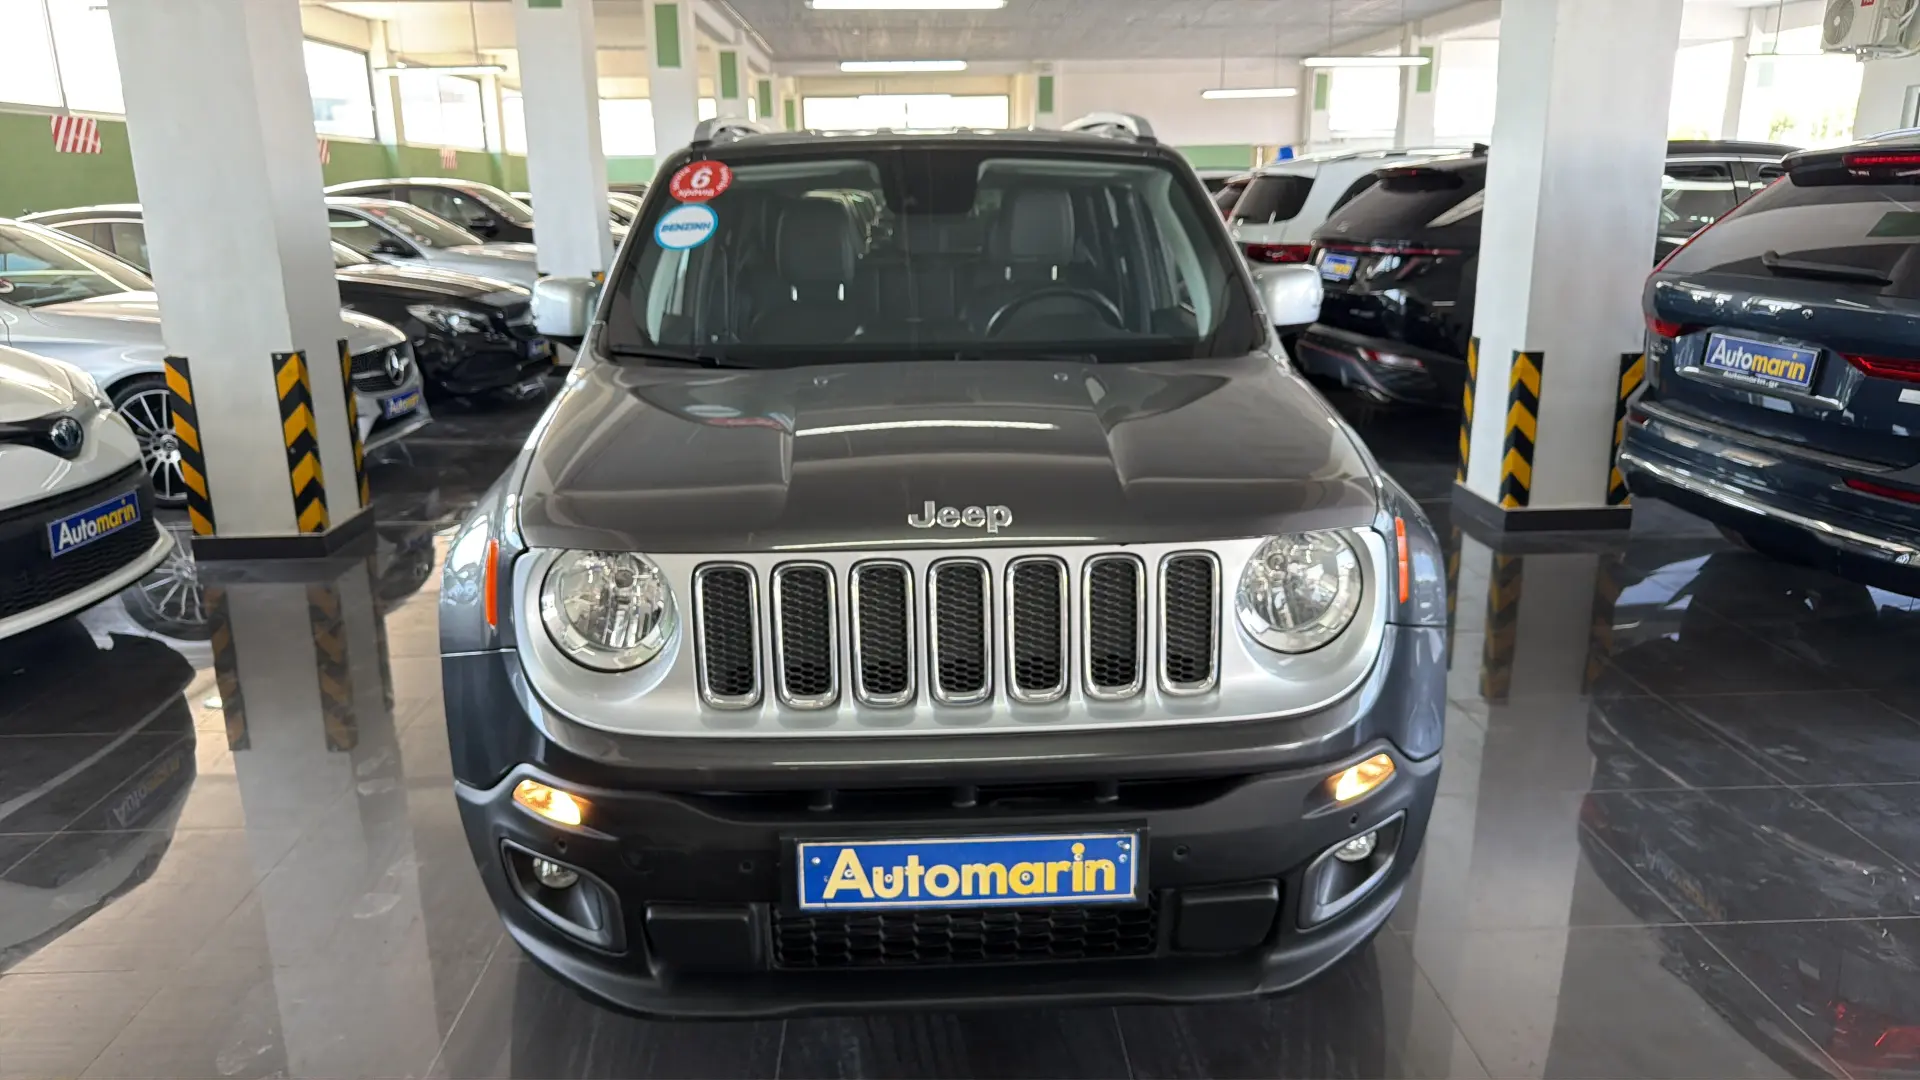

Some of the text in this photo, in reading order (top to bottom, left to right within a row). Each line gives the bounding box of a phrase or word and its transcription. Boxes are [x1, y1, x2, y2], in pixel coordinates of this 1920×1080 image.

[690, 166, 713, 189] 6
[1710, 339, 1806, 381] Automarin
[58, 499, 136, 550] Automarin
[907, 500, 1013, 533] Jeep
[822, 842, 1116, 900] Automarin
